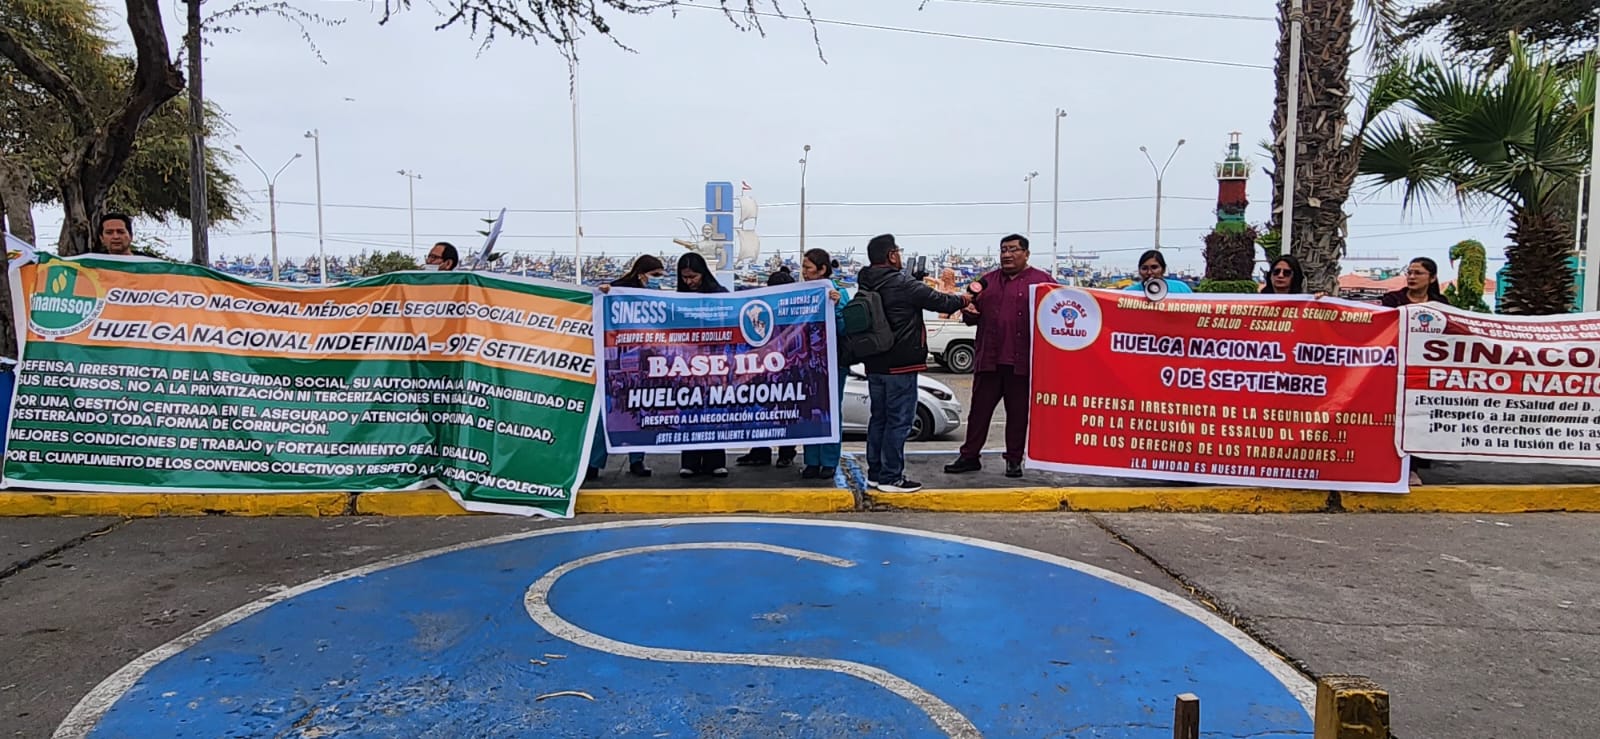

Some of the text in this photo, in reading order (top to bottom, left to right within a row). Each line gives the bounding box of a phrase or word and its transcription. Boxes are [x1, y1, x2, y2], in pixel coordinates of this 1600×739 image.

[30, 293, 93, 318] inamssop
[108, 289, 205, 307] SINDICATO
[208, 296, 298, 317] NACIONAL
[303, 300, 368, 317] MÉDICO
[371, 302, 400, 316] DEL
[404, 302, 465, 316] SEGURO
[466, 303, 522, 324] SOCIAL
[527, 314, 556, 330] DEL
[611, 300, 667, 325] SINESSS
[1117, 297, 1373, 323] SINDICATO NACIONAL DE OBSTETRAS DEL SEGURO SOCIAL
[1196, 316, 1295, 332] DE SALUD ESSALUD.
[1468, 325, 1579, 341] DEL SEGURO SOCIAL
[1503, 322, 1579, 333] NACIONAL DE
[93, 322, 595, 374] HUELGA NACIONAL INDEFINIDA SETIEMBRE
[1113, 334, 1396, 365] HUELGA NACIONAL INDEFINIDA
[1423, 340, 1600, 368] SINACO
[648, 352, 785, 377] BASE ILO
[19, 375, 450, 403] SUS RECURSOS. NO A LA PRIVATIZACIÓN NI TERCERIZACIONES EN
[79, 363, 168, 379] IRRESTRICTA
[173, 369, 189, 380] DE
[193, 370, 209, 382] LA
[213, 370, 291, 387] SEGURIDAD
[295, 377, 349, 390] SOCIAL,
[353, 377, 370, 388] SU
[467, 379, 564, 408] INTANGIBILIDAD
[567, 400, 585, 412] DE
[1162, 368, 1325, 394] 9 DE SEPTIEMBRE
[1429, 368, 1512, 391] PARO
[628, 382, 806, 409] HUELGA NACIONAL
[1036, 392, 1329, 424] POR LA DEFENSA IRRESTRICTA DE LA SEGURIDAD
[1415, 395, 1594, 411] ¡Exclusión de EsSalud del D.
[13, 409, 329, 435] DESTERRANDO TODA FORMA DE CORRUPCIÓN.
[40, 396, 69, 407] UNA
[74, 396, 138, 411] GESTIÓN
[142, 401, 218, 416] CENTRADA
[222, 405, 238, 416] EN
[242, 406, 257, 417] EL
[261, 408, 348, 422] ASEGURADO
[362, 409, 429, 423] ATENCIÓN
[478, 418, 494, 431] DE
[496, 422, 555, 443] CALIDAD,
[641, 409, 800, 427] ¡RESPETO LA NEGOCIACIÓN COLECTIVA!
[1082, 414, 1104, 427] POR
[1110, 416, 1124, 429] LA
[1130, 418, 1195, 434] EXCLUSIÓN
[1201, 423, 1215, 436] DE
[1221, 425, 1274, 439] ESSALUD
[1280, 428, 1294, 441] DL
[1429, 409, 1589, 424] ¡Respeto a la autonomía
[1429, 422, 1584, 437] ¡Por los derechos de los
[10, 429, 439, 456] MEJORES CONDICIONES DE TRABAJO FORTALECIMIENTO REAL
[1075, 433, 1097, 446] POR
[1103, 435, 1125, 448] LOS
[1131, 437, 1192, 454] DERECHOS
[1198, 442, 1213, 455] DE
[1218, 443, 1240, 457] LOS
[1461, 437, 1591, 451] ¡No a la fusión de la
[29, 451, 43, 462] EL
[45, 451, 144, 467] CUMPLIMIENTO
[146, 457, 163, 468] DE
[165, 458, 192, 469] LOS
[194, 459, 269, 473] CONVENIOS
[271, 461, 353, 475] COLECTIVOS
[356, 464, 365, 475] Y
[367, 462, 417, 475] RESPETO
[418, 464, 428, 475] A
[497, 477, 566, 498] COLECTIVA.
[1131, 458, 1320, 480] ¡LA UNIDAD ES NUESTRA FORTALEZA!
